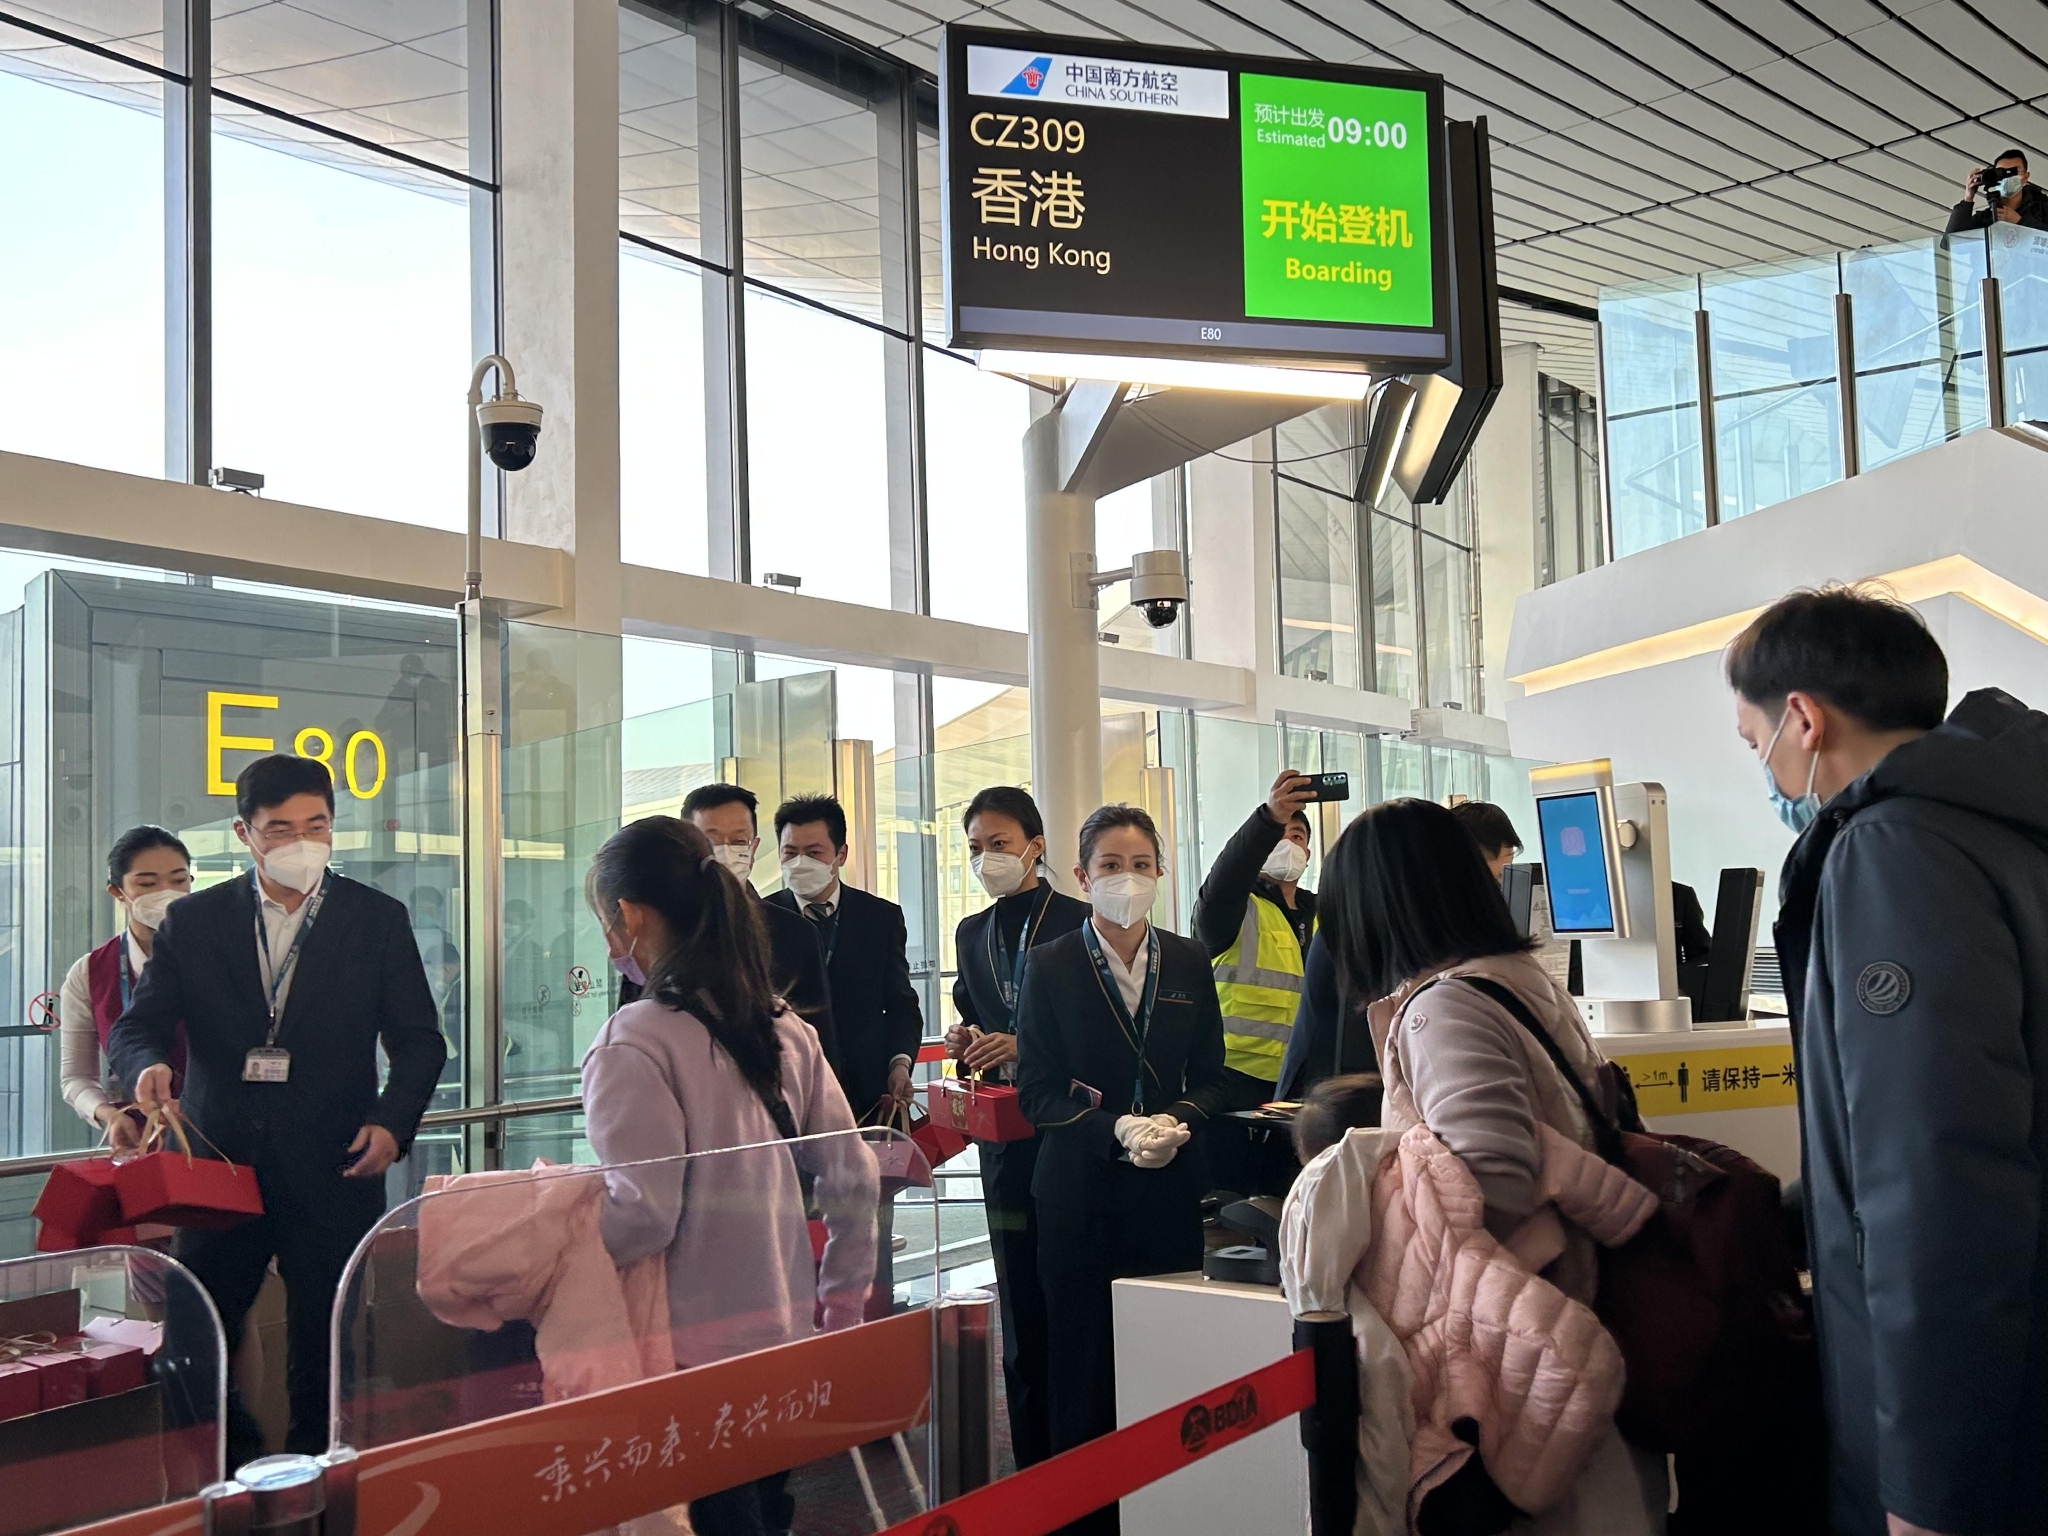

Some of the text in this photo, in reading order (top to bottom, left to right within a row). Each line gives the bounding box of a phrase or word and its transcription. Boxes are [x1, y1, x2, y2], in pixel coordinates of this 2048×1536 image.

[1065, 62, 1178, 92] 中国南方航空
[1065, 84, 1178, 106] CHINA SOUTHERN
[1254, 102, 1326, 129] 预计出发
[969, 111, 1086, 155] CZ309
[1256, 128, 1326, 149] Estimated
[1327, 117, 1408, 150] 09:00
[970, 166, 1087, 230] 香港
[1261, 198, 1414, 249] 开始登机
[972, 236, 1112, 275] Hong Kong
[1285, 257, 1393, 291] Boarding
[1200, 327, 1222, 342] E80
[207, 691, 387, 800] E80
[1701, 1063, 1797, 1093] 请保持一米
